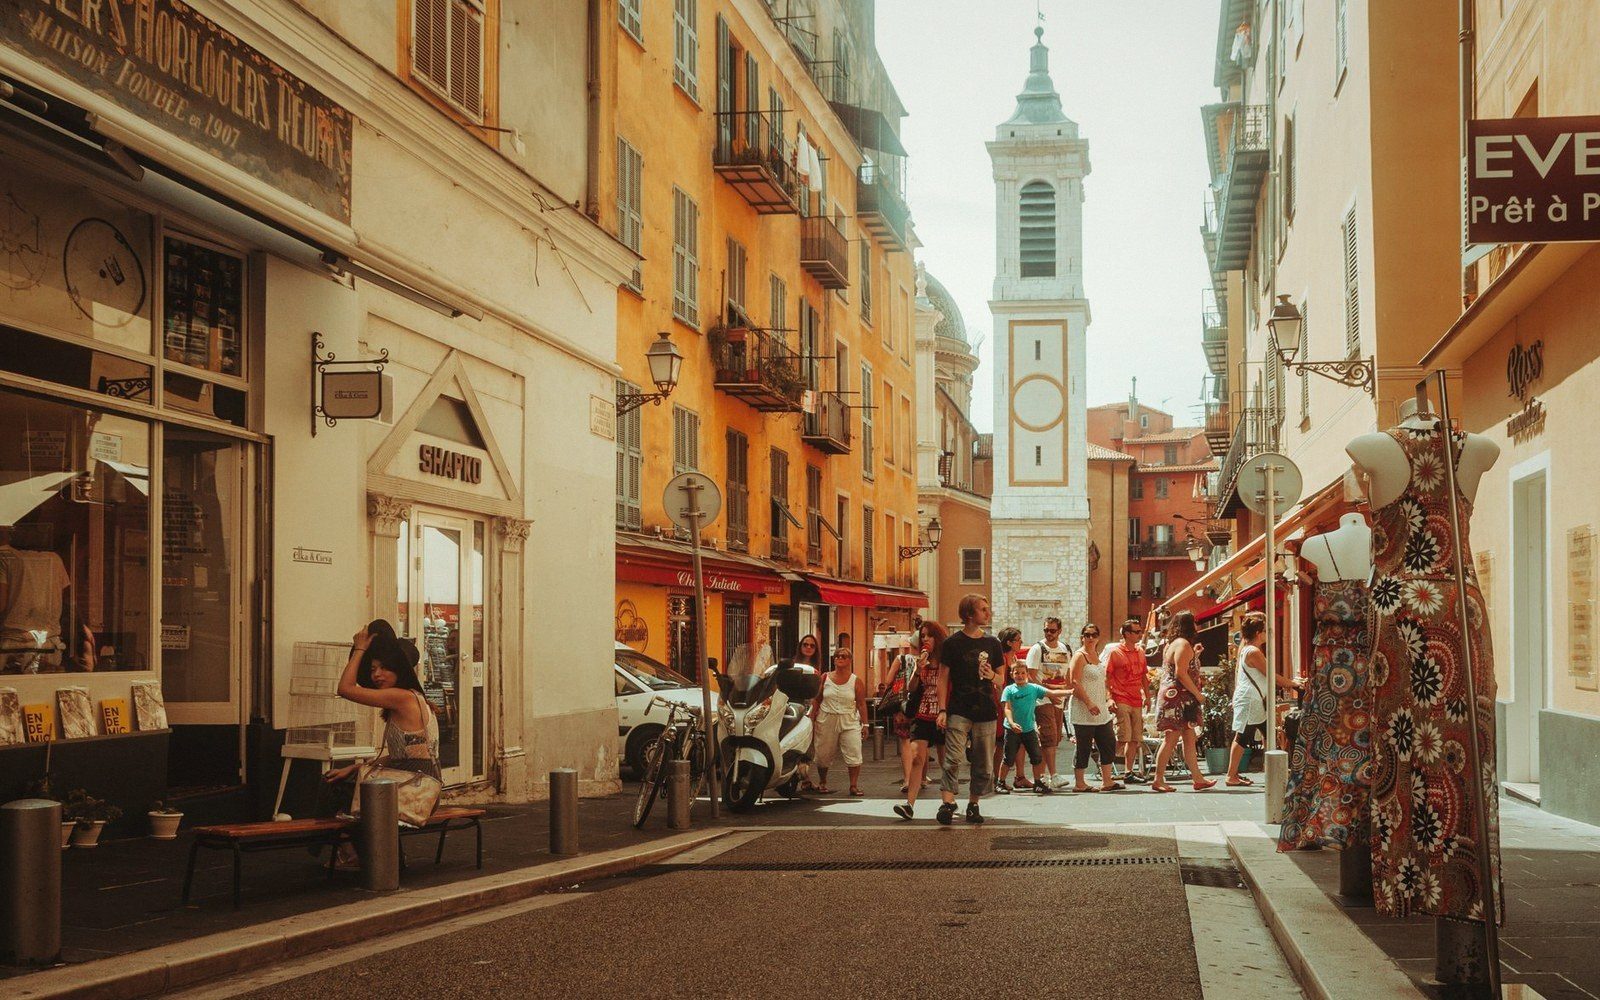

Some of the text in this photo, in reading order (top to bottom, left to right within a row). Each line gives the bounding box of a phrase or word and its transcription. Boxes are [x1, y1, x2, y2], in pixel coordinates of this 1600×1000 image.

[134, 0, 271, 130] HORLOGERS
[28, 10, 110, 77] MAISON
[205, 112, 241, 149] 1907
[1471, 195, 1535, 223] Prêt
[1547, 195, 1567, 222] à
[419, 444, 482, 484] SHAPKO
[707, 576, 742, 592] Juliette
[26, 713, 43, 724] EN
[104, 707, 119, 717] EN
[28, 723, 43, 734] DE
[105, 716, 120, 727] DE
